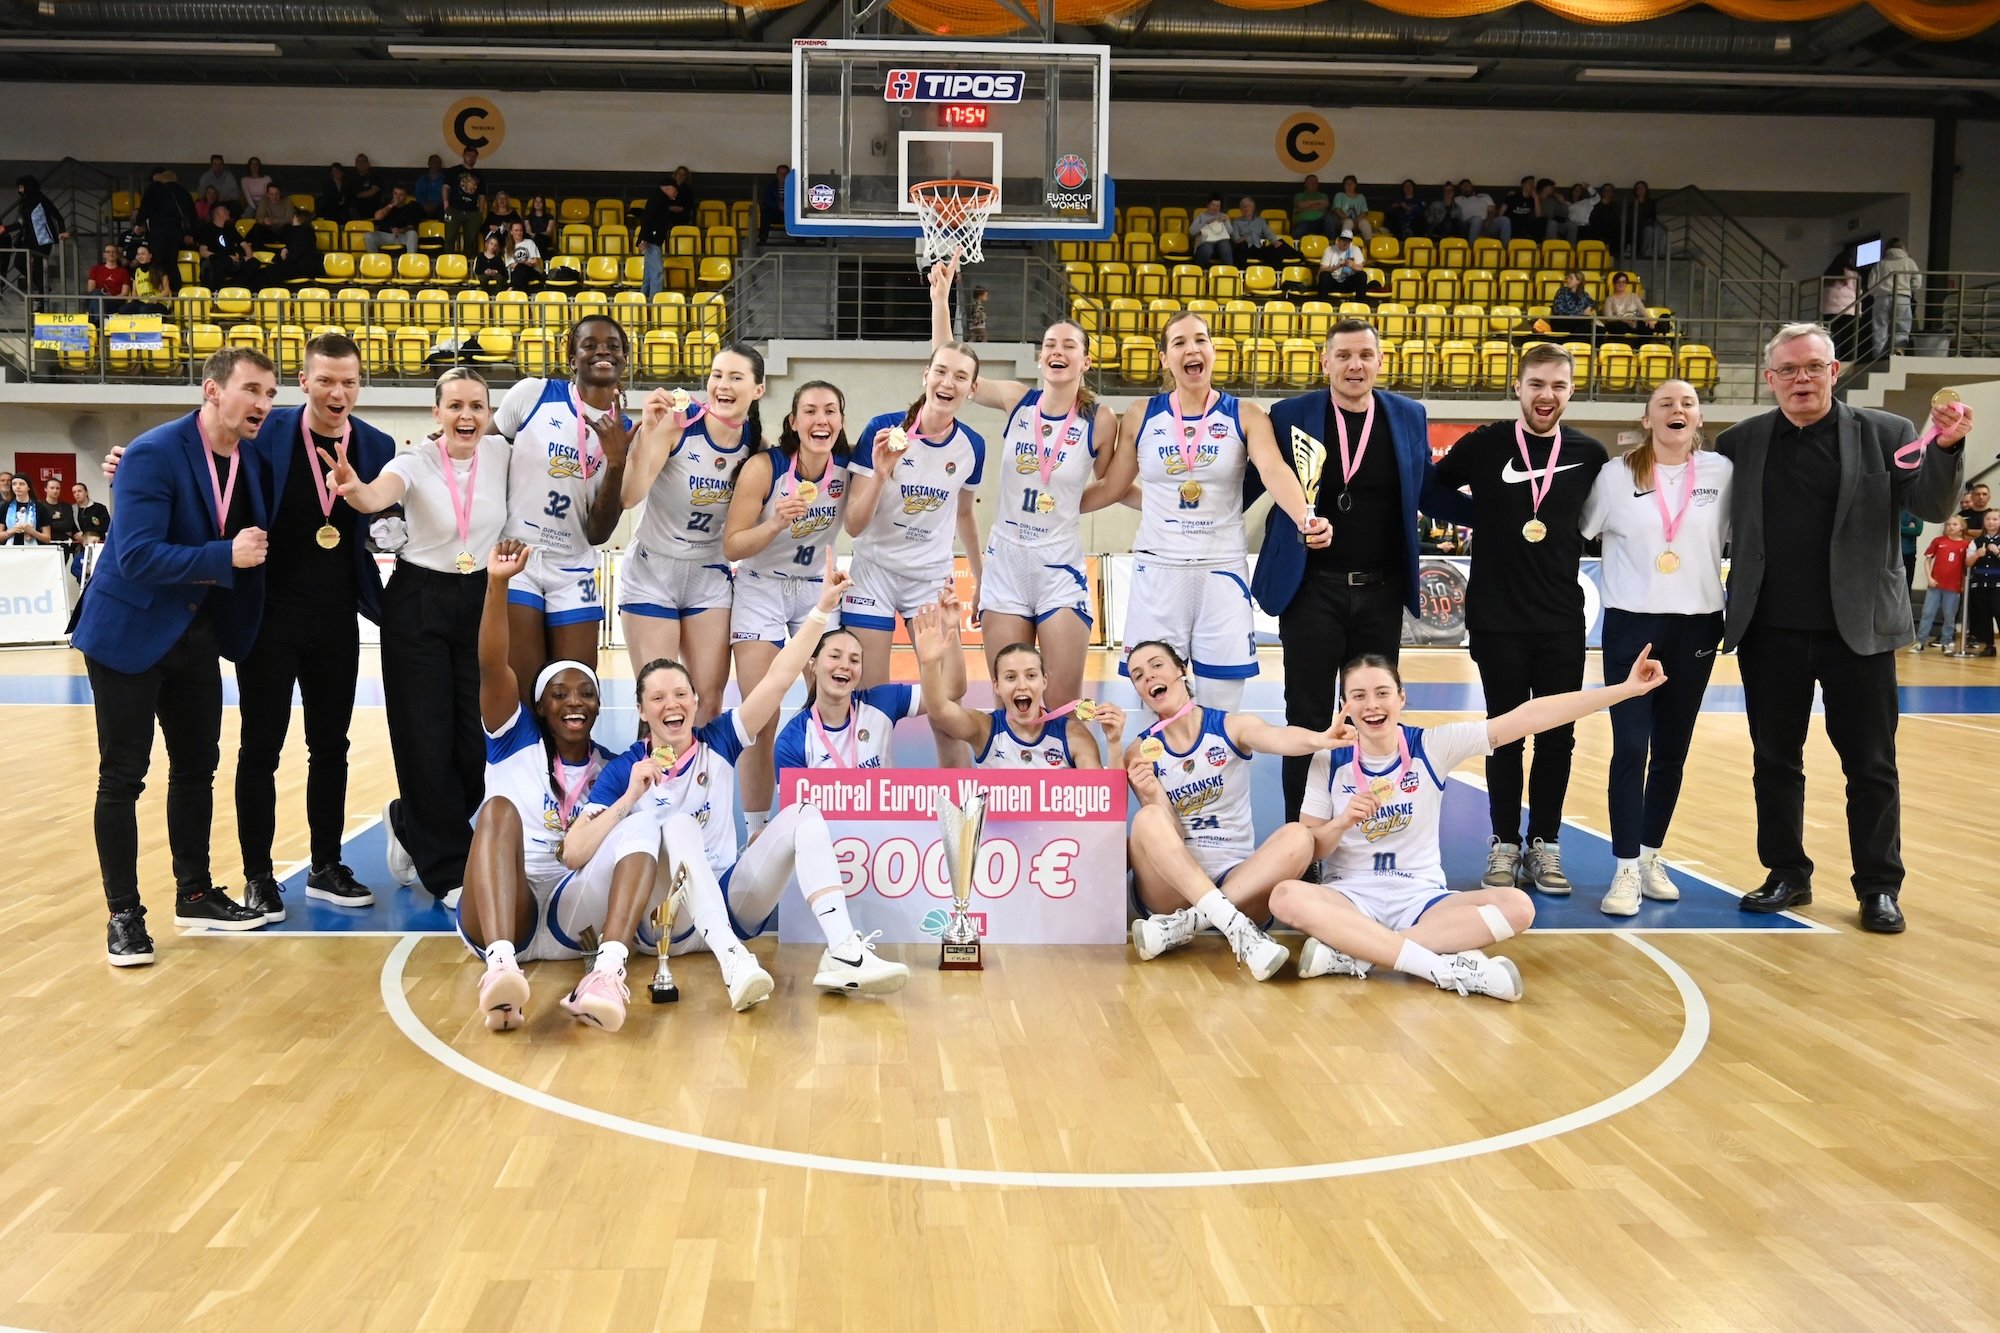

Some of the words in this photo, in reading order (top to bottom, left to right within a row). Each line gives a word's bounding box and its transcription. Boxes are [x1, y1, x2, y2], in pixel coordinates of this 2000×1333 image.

[924, 75, 1016, 99] TIPOS
[945, 107, 986, 123] 17:54
[454, 107, 489, 149] C
[1286, 123, 1320, 163] C
[1046, 193, 1092, 202] EUROCUP
[1050, 201, 1088, 209] WOMEN
[543, 490, 571, 520] 32
[1022, 487, 1038, 514] 11
[792, 545, 816, 566] 18
[1948, 552, 1955, 562] 8
[577, 577, 597, 603] 32
[851, 596, 875, 606] TIPOS
[796, 778, 871, 811] Central
[1040, 780, 1110, 817] League
[1029, 837, 1080, 899] €
